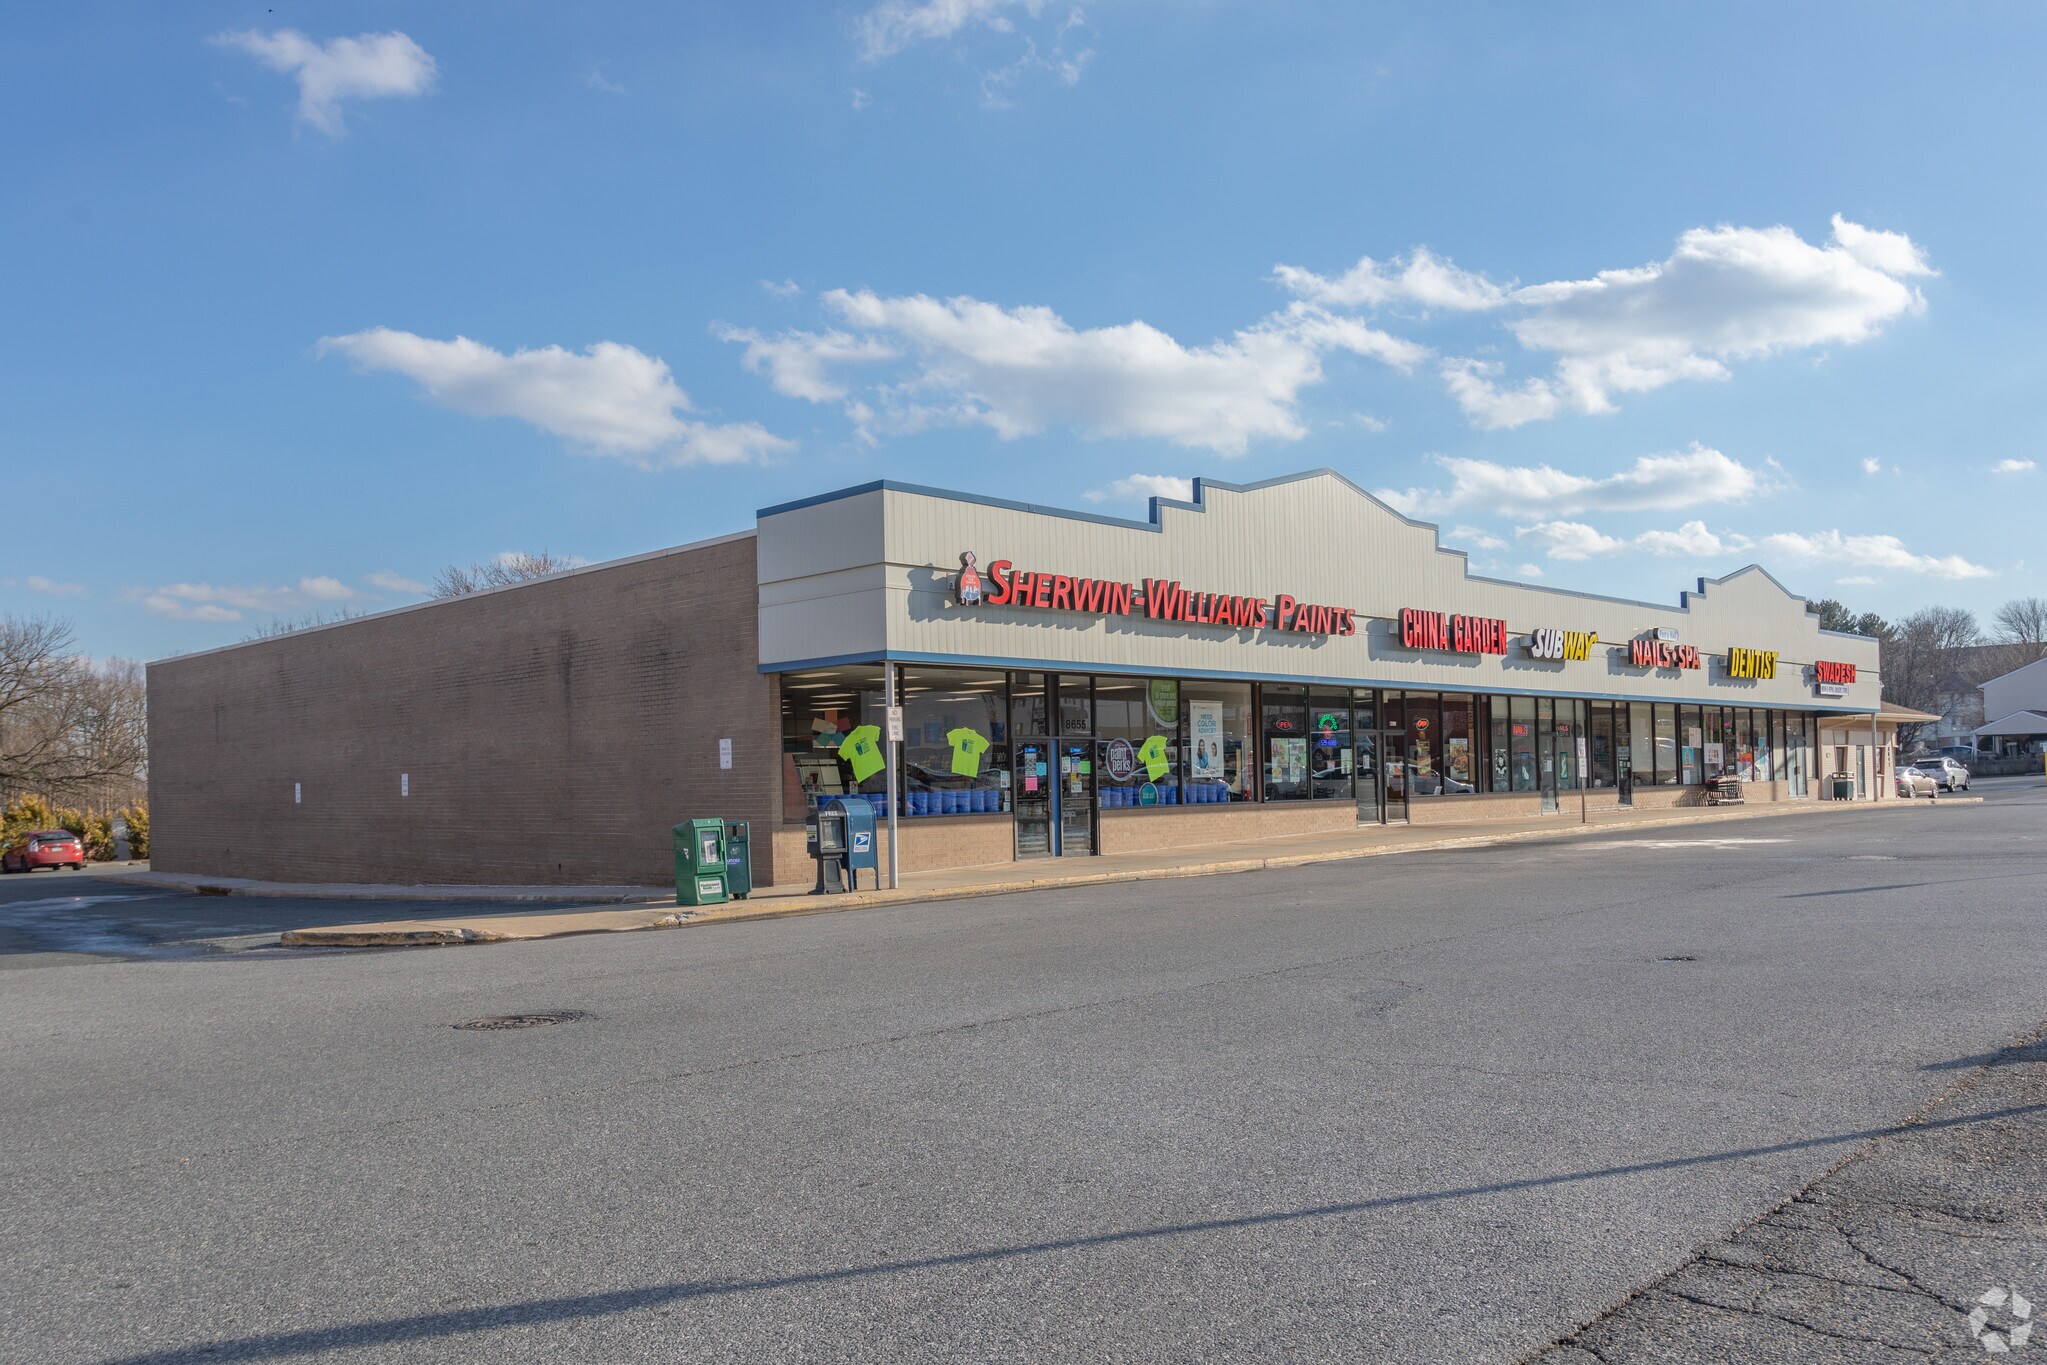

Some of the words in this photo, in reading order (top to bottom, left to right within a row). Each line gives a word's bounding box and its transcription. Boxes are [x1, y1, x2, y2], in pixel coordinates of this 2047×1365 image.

[1276, 594, 1356, 636] PAINTS
[1401, 607, 1448, 650] CHINA
[1453, 613, 1507, 655] GARDEN
[1532, 628, 1598, 661] SUBWAY
[1632, 640, 1670, 668] NAILS
[1677, 645, 1701, 669] SPA
[1730, 647, 1779, 679] DENTIST
[1817, 660, 1856, 683] SWADESH
[1065, 719, 1086, 730] 8655
[1513, 725, 1528, 735] NAILS
[1110, 747, 1127, 761] paint
[1112, 758, 1131, 773] perks
